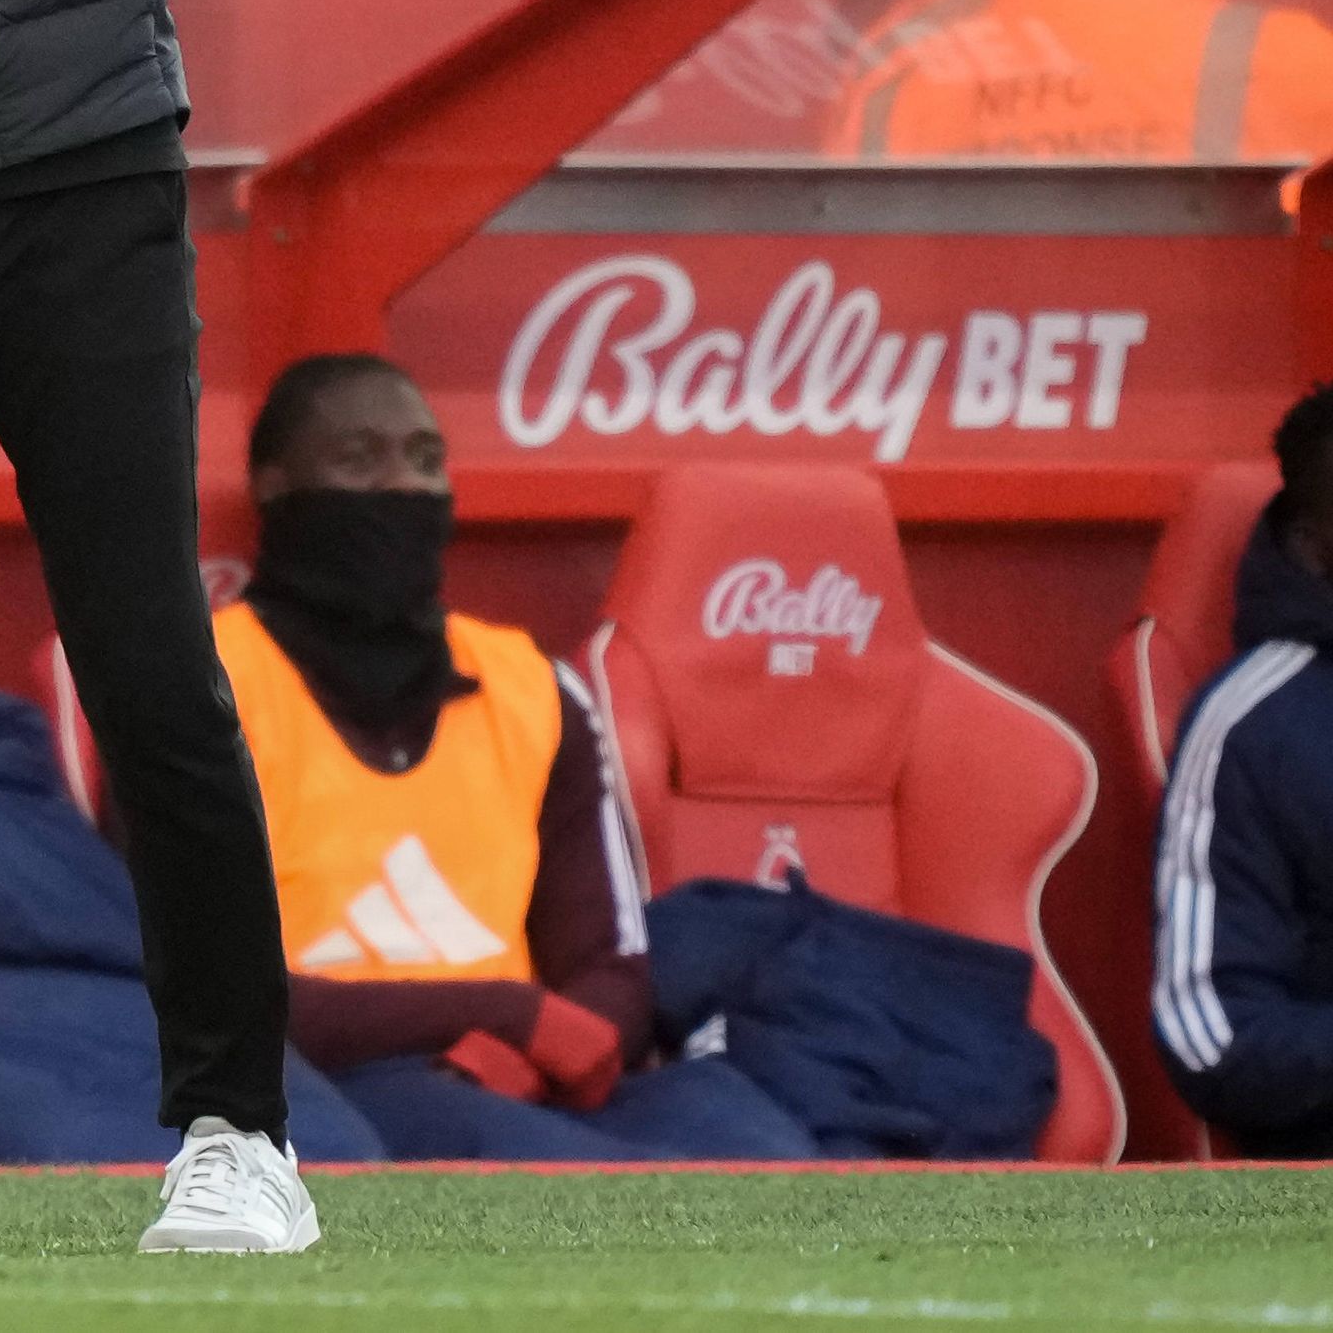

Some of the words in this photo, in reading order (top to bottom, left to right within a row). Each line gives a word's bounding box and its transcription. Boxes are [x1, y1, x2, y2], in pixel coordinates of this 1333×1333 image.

[498, 255, 947, 464] Bally
[950, 312, 1148, 431] BET
[703, 558, 882, 656] Bally
